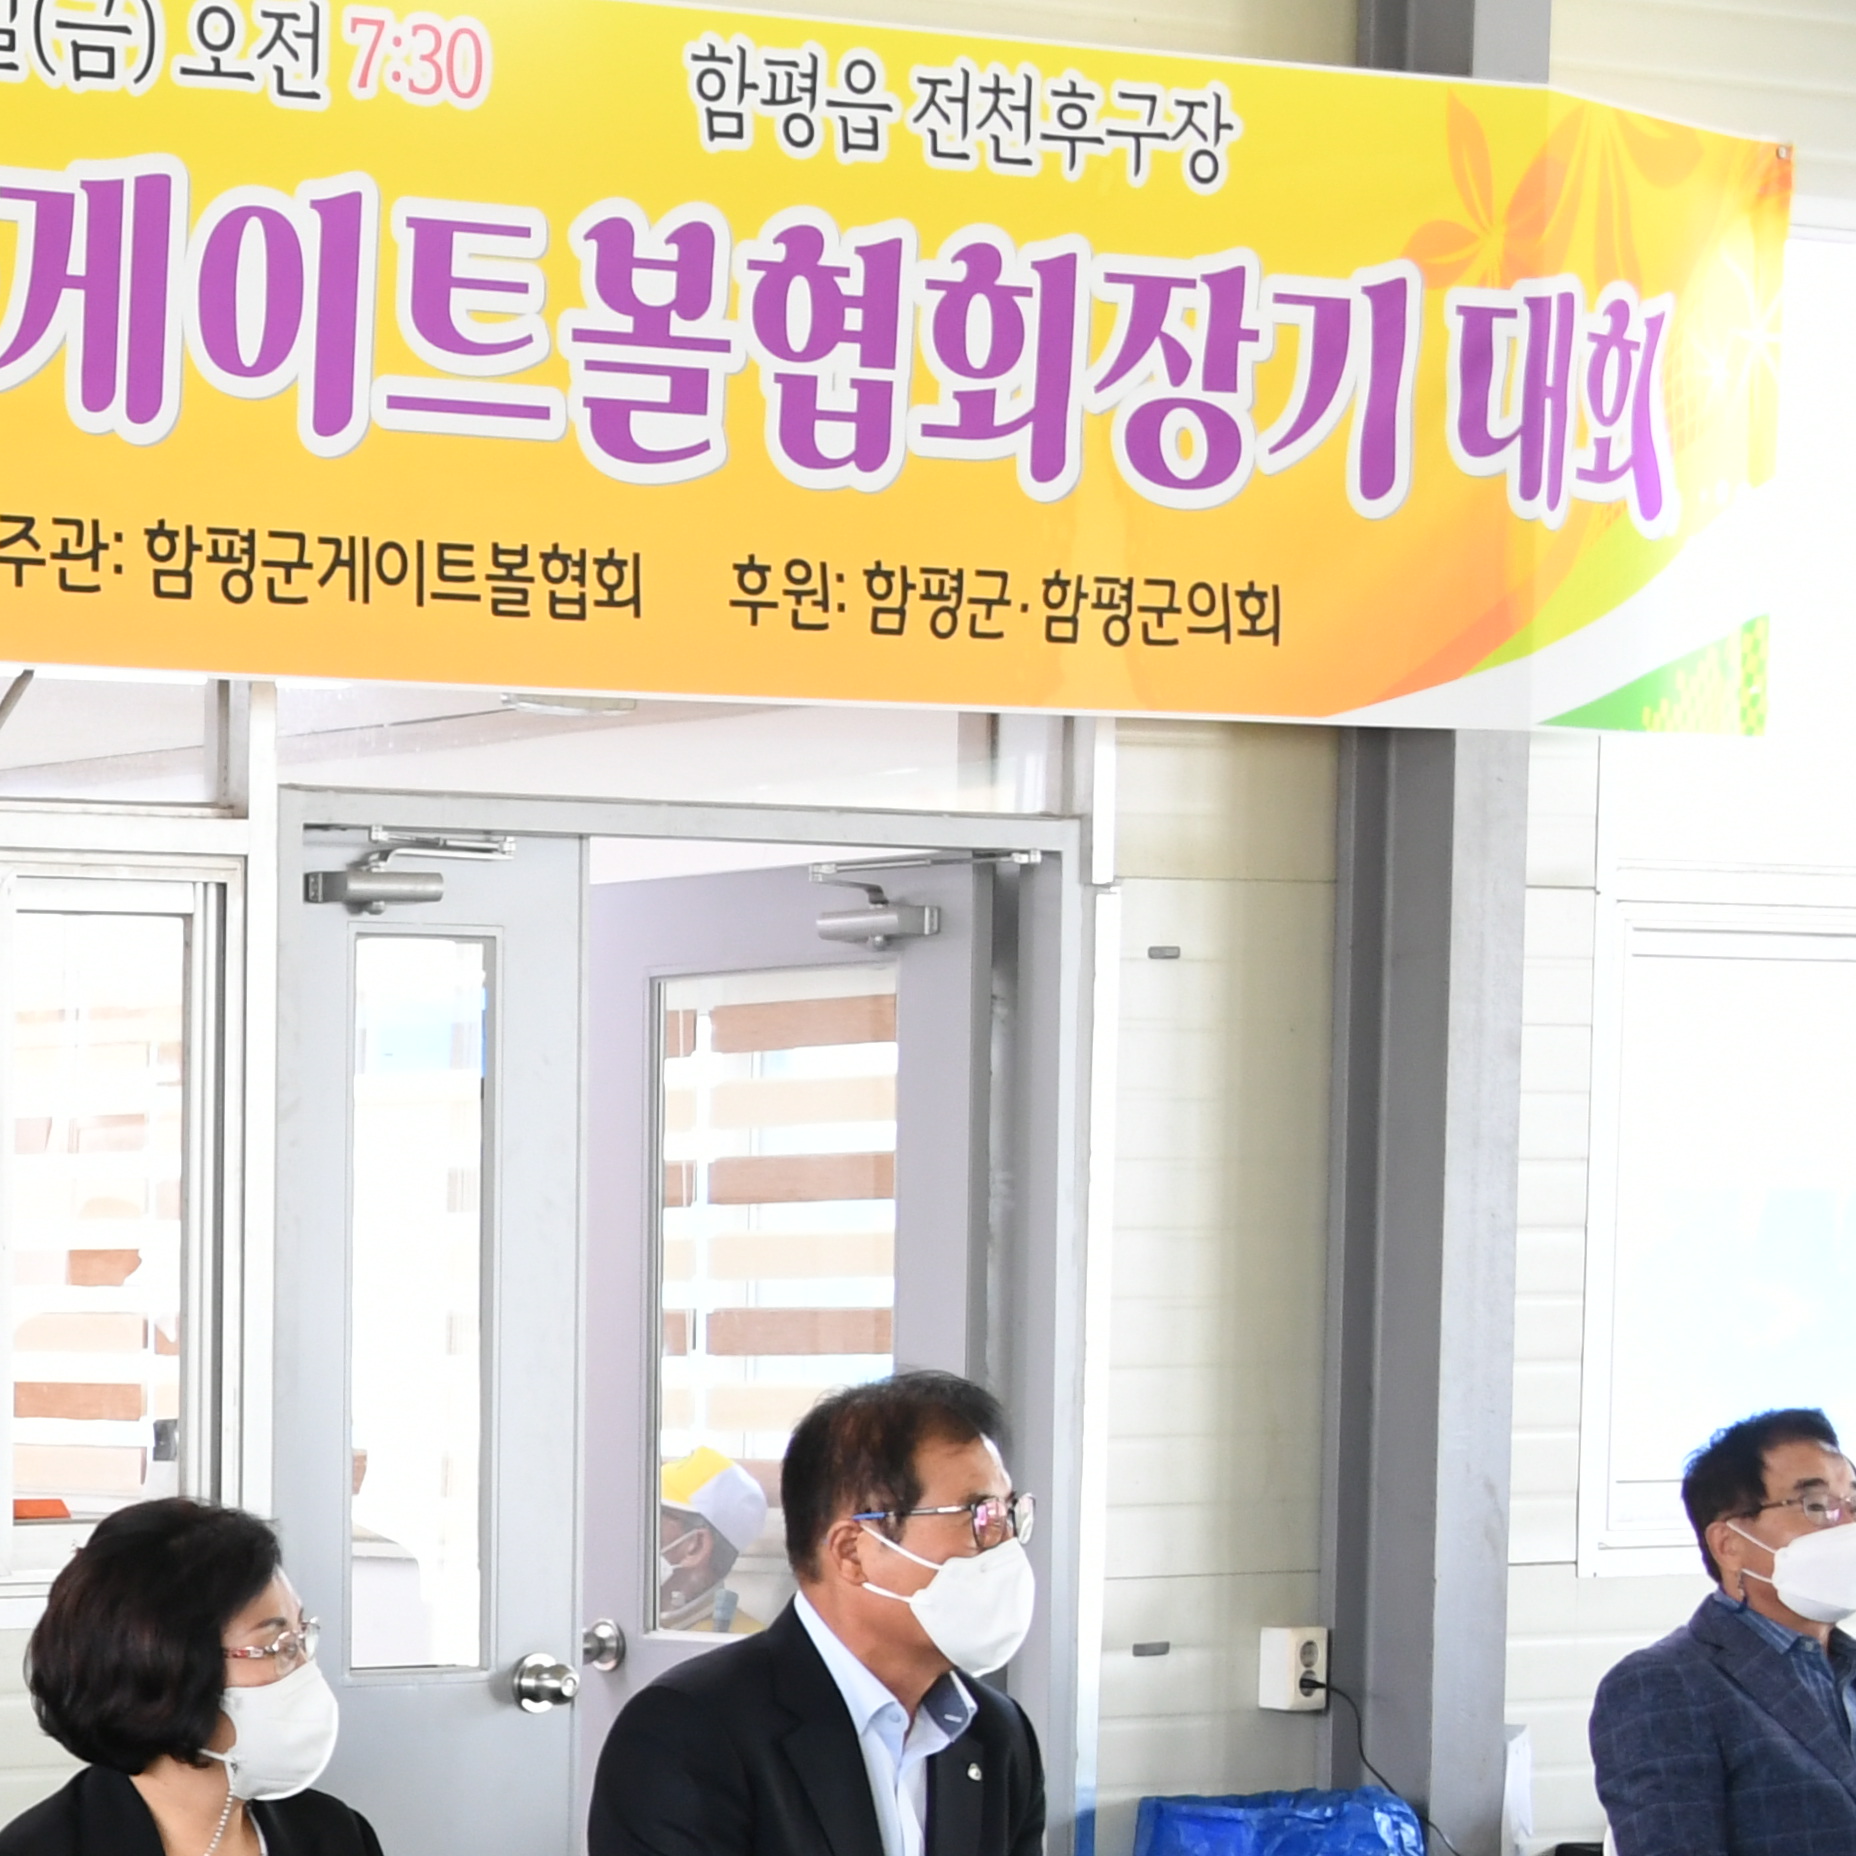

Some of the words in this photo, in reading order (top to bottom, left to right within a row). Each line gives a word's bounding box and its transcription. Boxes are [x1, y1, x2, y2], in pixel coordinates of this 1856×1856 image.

[179, 0, 321, 100] 오전
[348, 17, 484, 99] 7:30
[690, 42, 893, 154] 함평읍
[912, 66, 1234, 185] 전천후구장
[1454, 287, 1666, 521] 대회
[143, 518, 642, 622] 함평군게이트볼협회
[728, 553, 846, 632] 후원:
